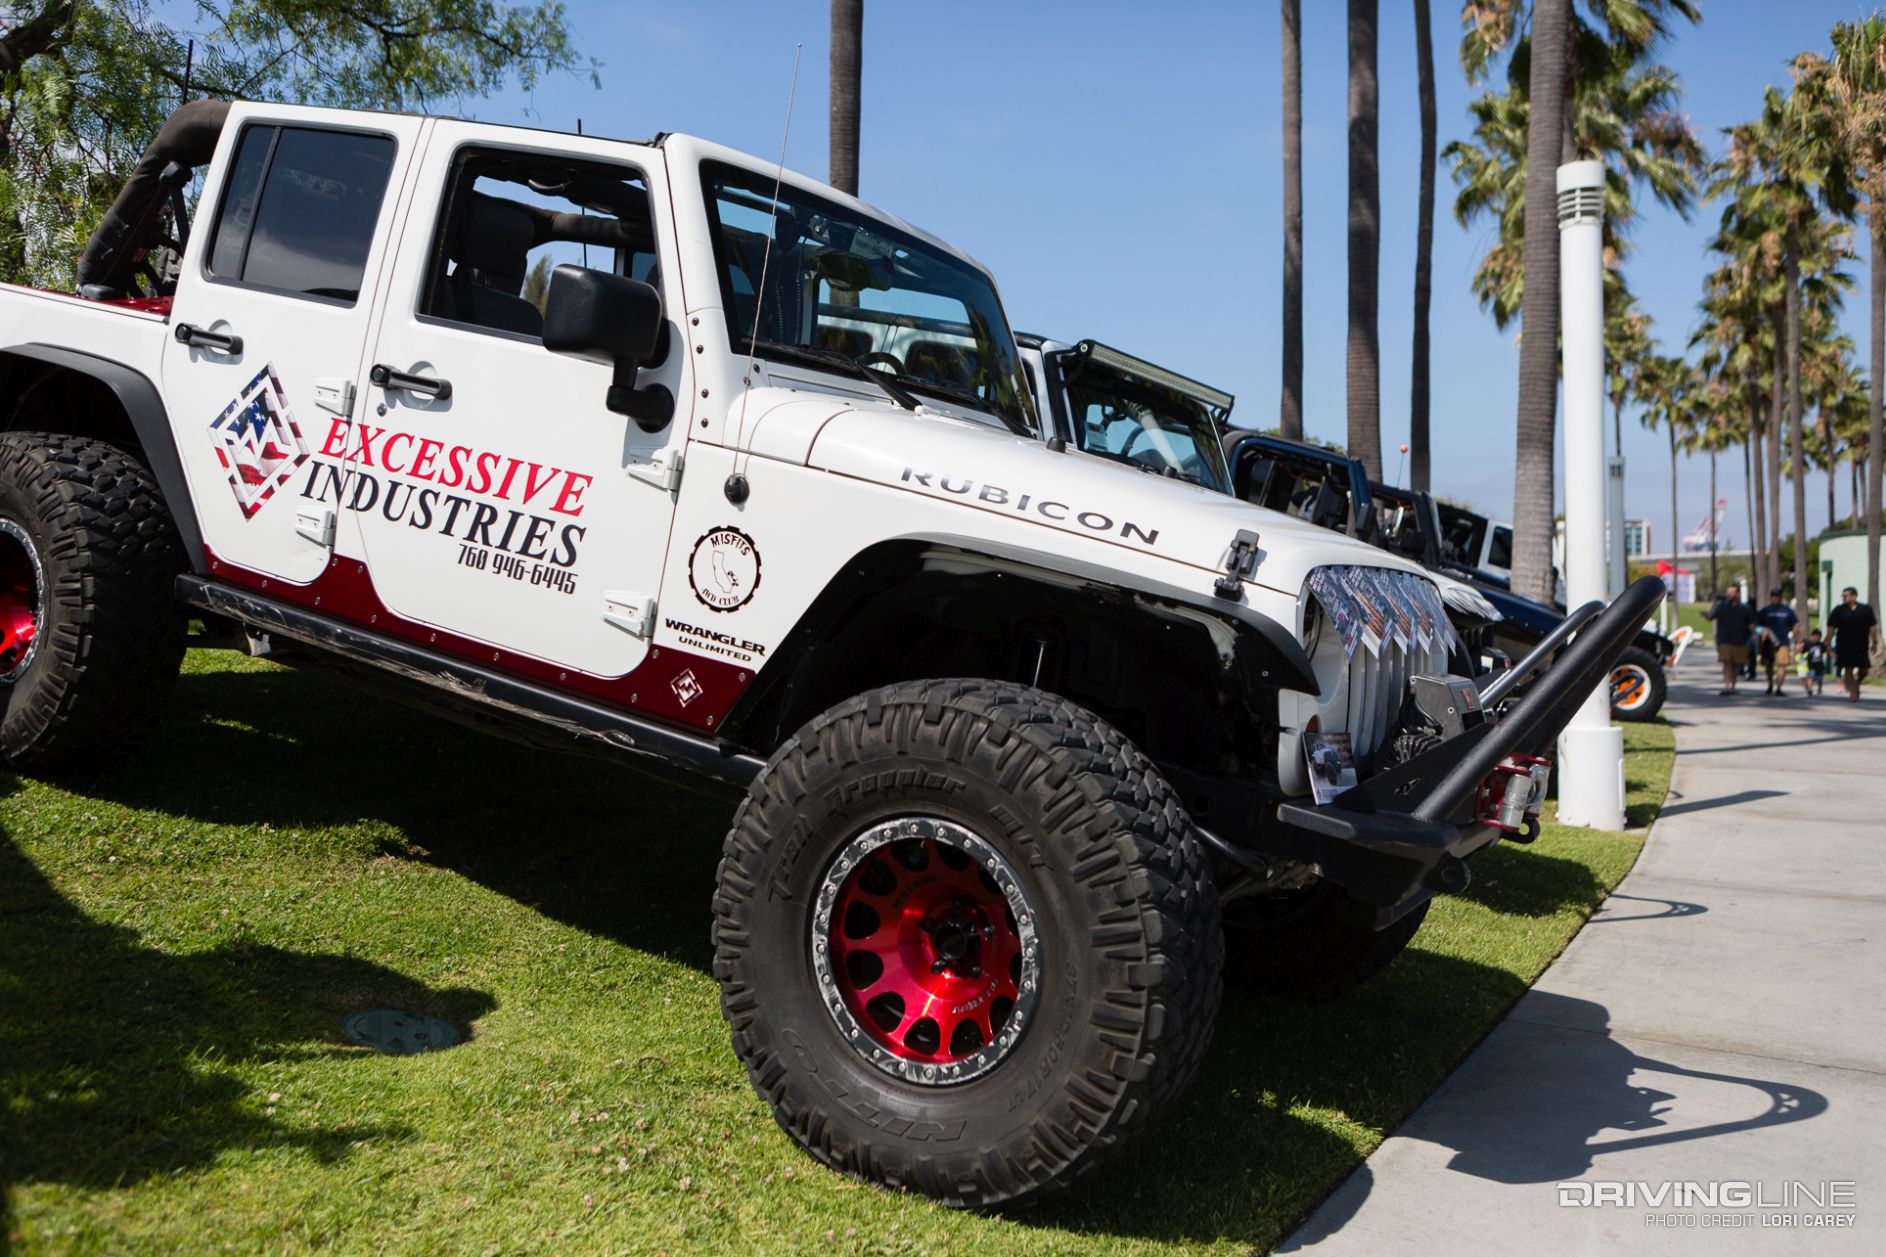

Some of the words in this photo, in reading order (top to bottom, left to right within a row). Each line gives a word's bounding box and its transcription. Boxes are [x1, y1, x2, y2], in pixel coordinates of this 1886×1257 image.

[320, 416, 593, 516] EXCESSIVE
[300, 460, 587, 567] INDUSTRIES
[901, 467, 1159, 546] RUBICON
[458, 543, 488, 570] 760
[492, 553, 578, 594] 946-6445
[710, 533, 751, 556] MISFITS
[665, 618, 766, 657] WRANGLER
[678, 636, 752, 662] UNLIMITED
[781, 1028, 969, 1143] NITTO
